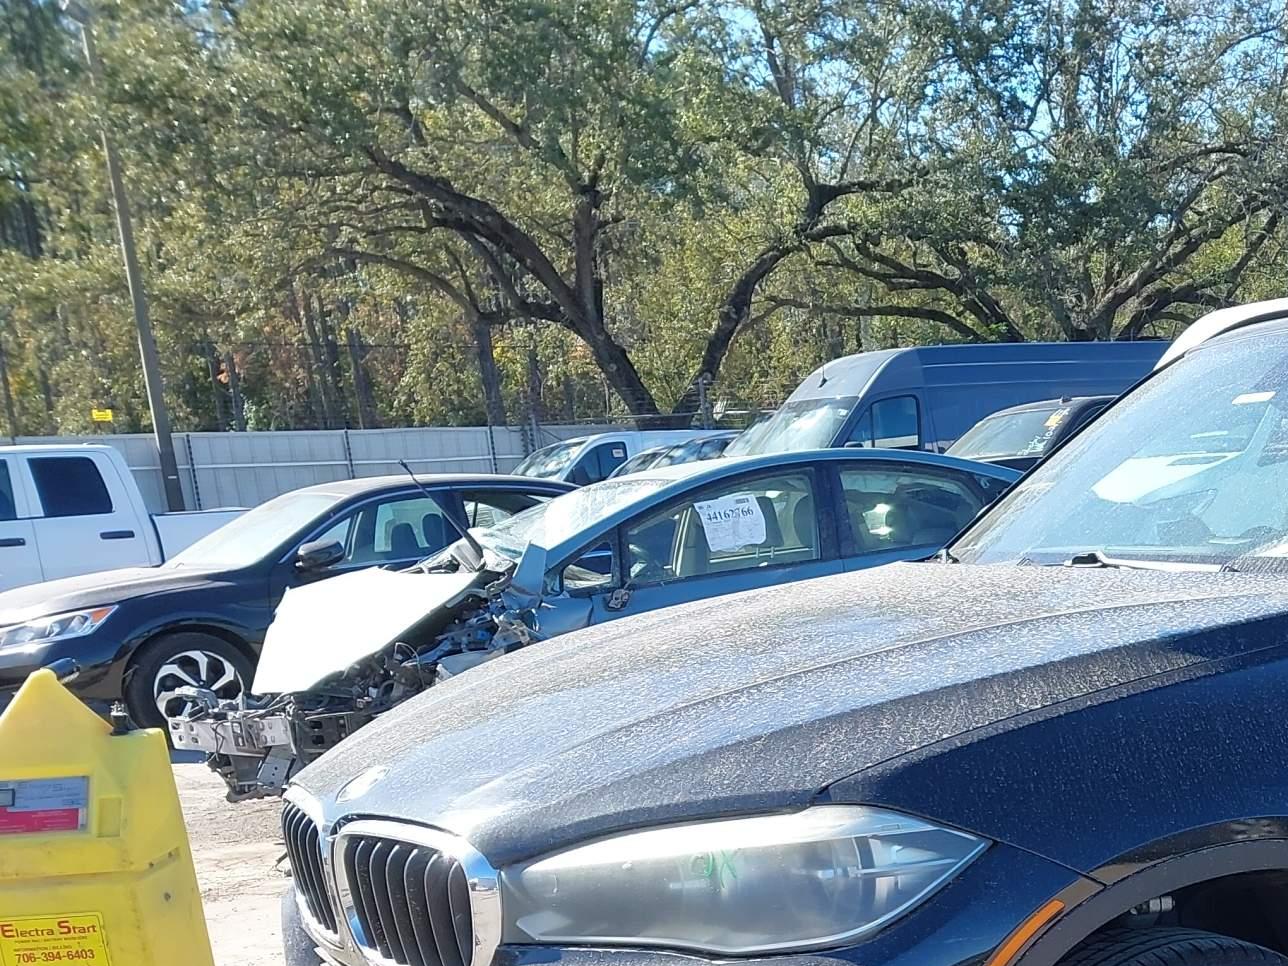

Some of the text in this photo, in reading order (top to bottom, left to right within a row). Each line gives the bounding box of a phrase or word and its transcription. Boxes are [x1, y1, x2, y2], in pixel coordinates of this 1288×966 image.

[0, 920, 97, 938] Electra Start
[15, 949, 95, 963] 706-394-6403
